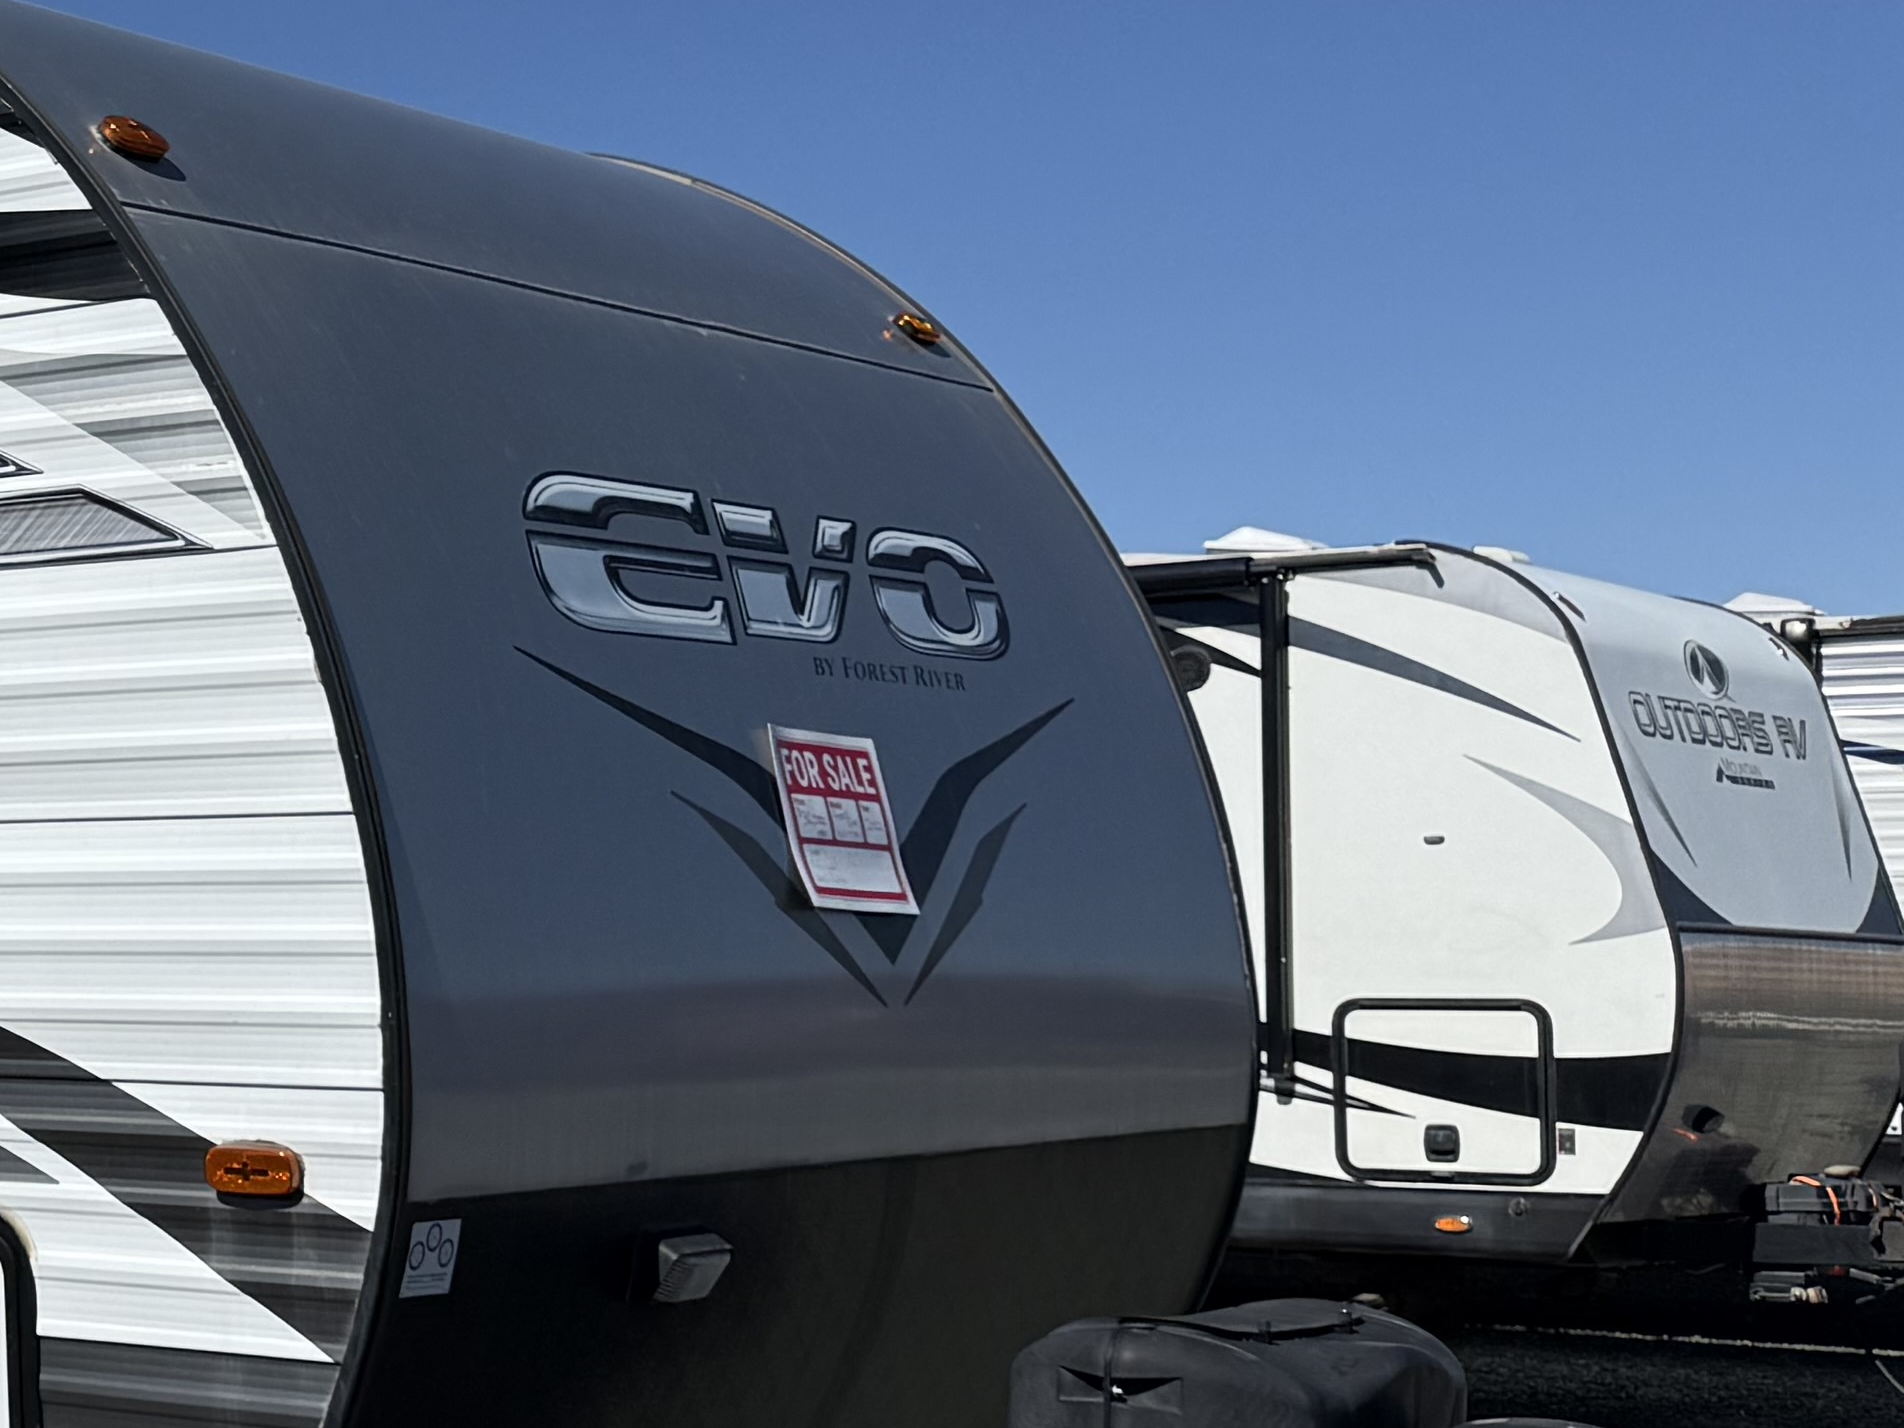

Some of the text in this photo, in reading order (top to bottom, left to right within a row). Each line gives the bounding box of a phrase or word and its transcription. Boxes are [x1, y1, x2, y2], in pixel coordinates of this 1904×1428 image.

[521, 470, 1011, 662] EVO
[1628, 690, 1807, 760] OUTDOORS RV
[780, 747, 877, 795] FOR SALE
